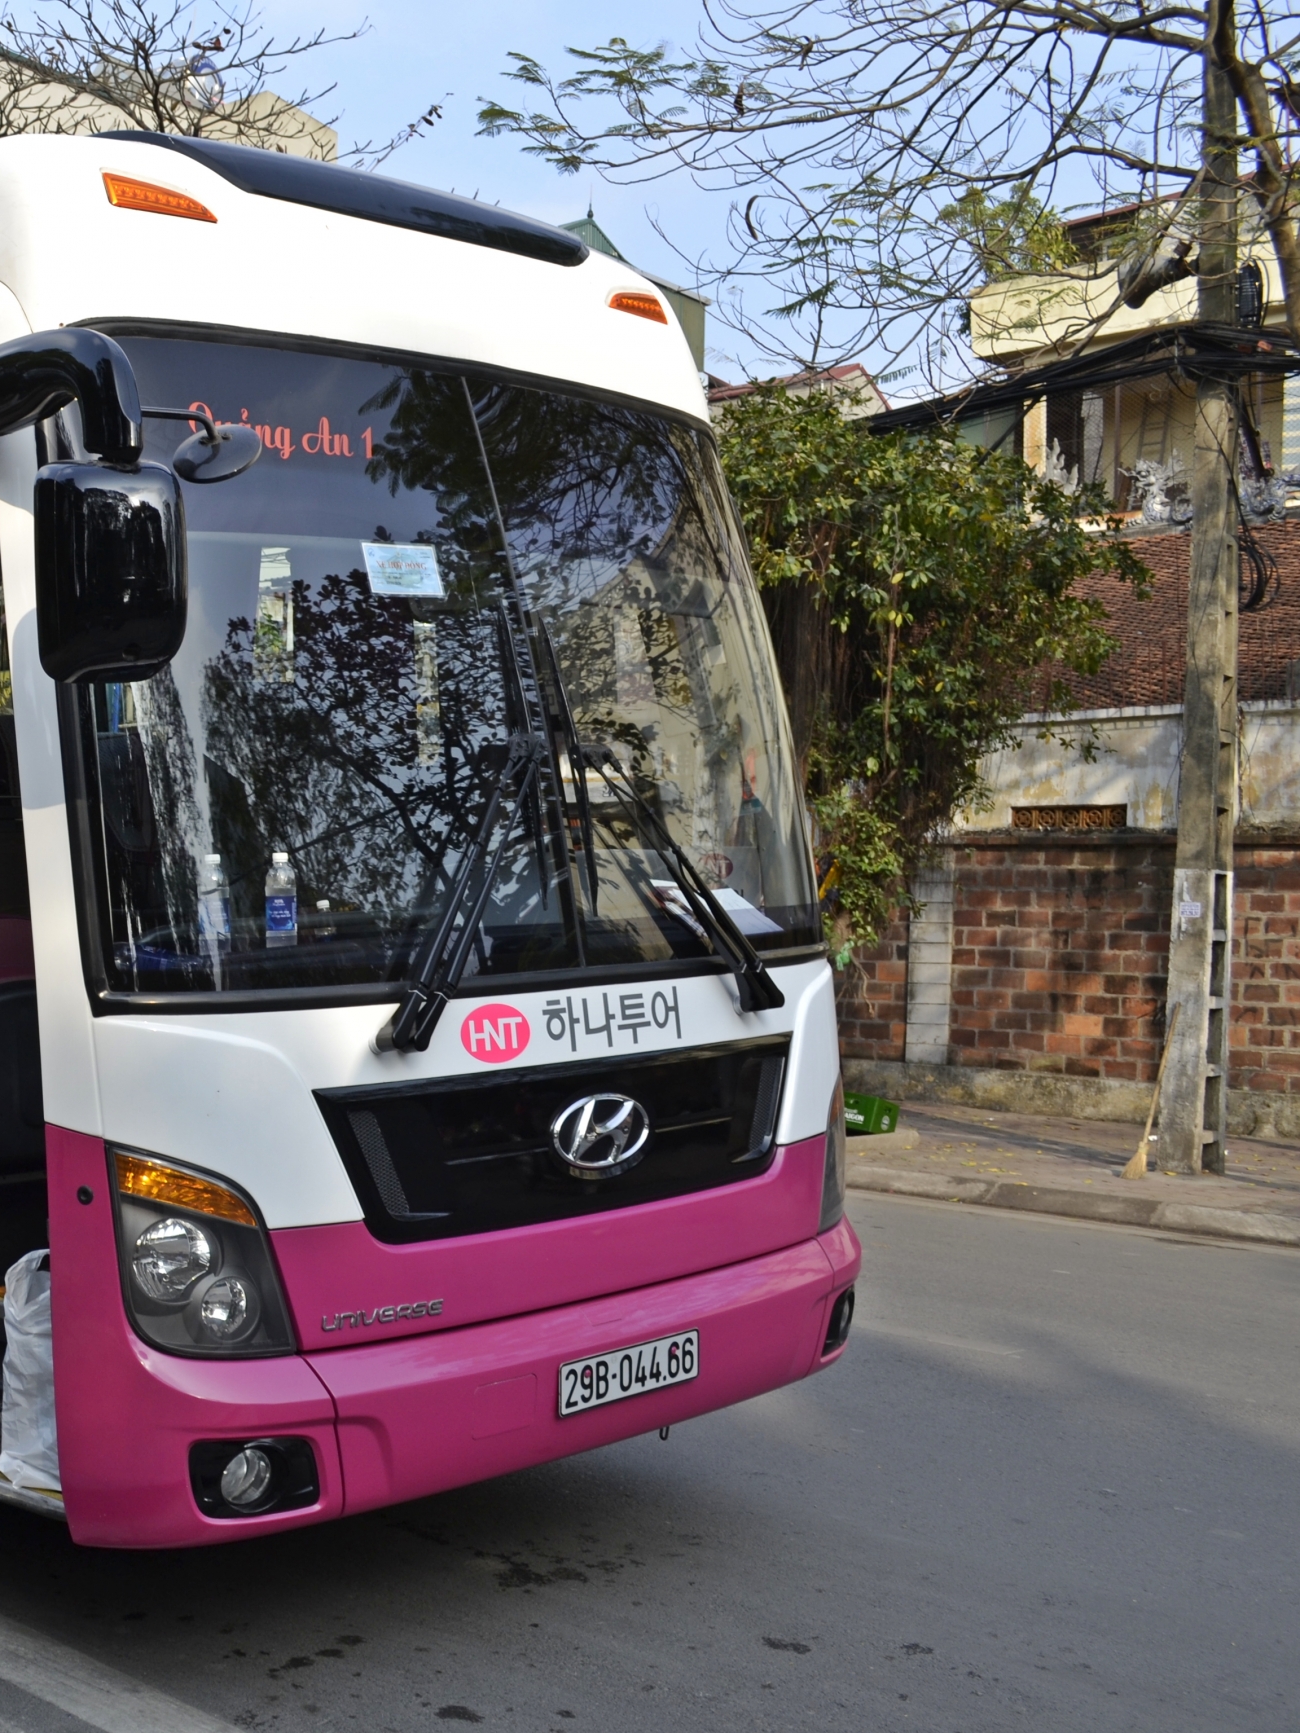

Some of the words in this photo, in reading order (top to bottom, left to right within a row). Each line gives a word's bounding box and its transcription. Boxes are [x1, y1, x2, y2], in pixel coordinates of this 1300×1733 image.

[188, 401, 296, 460] Qng
[302, 416, 354, 457] An
[361, 426, 374, 459] 1
[468, 1017, 522, 1052] HNT
[542, 986, 682, 1052] 하나투어
[844, 1111, 865, 1122] AIGON
[321, 1298, 444, 1332] UNIVERSE
[565, 1337, 694, 1409] 29B-044.66
